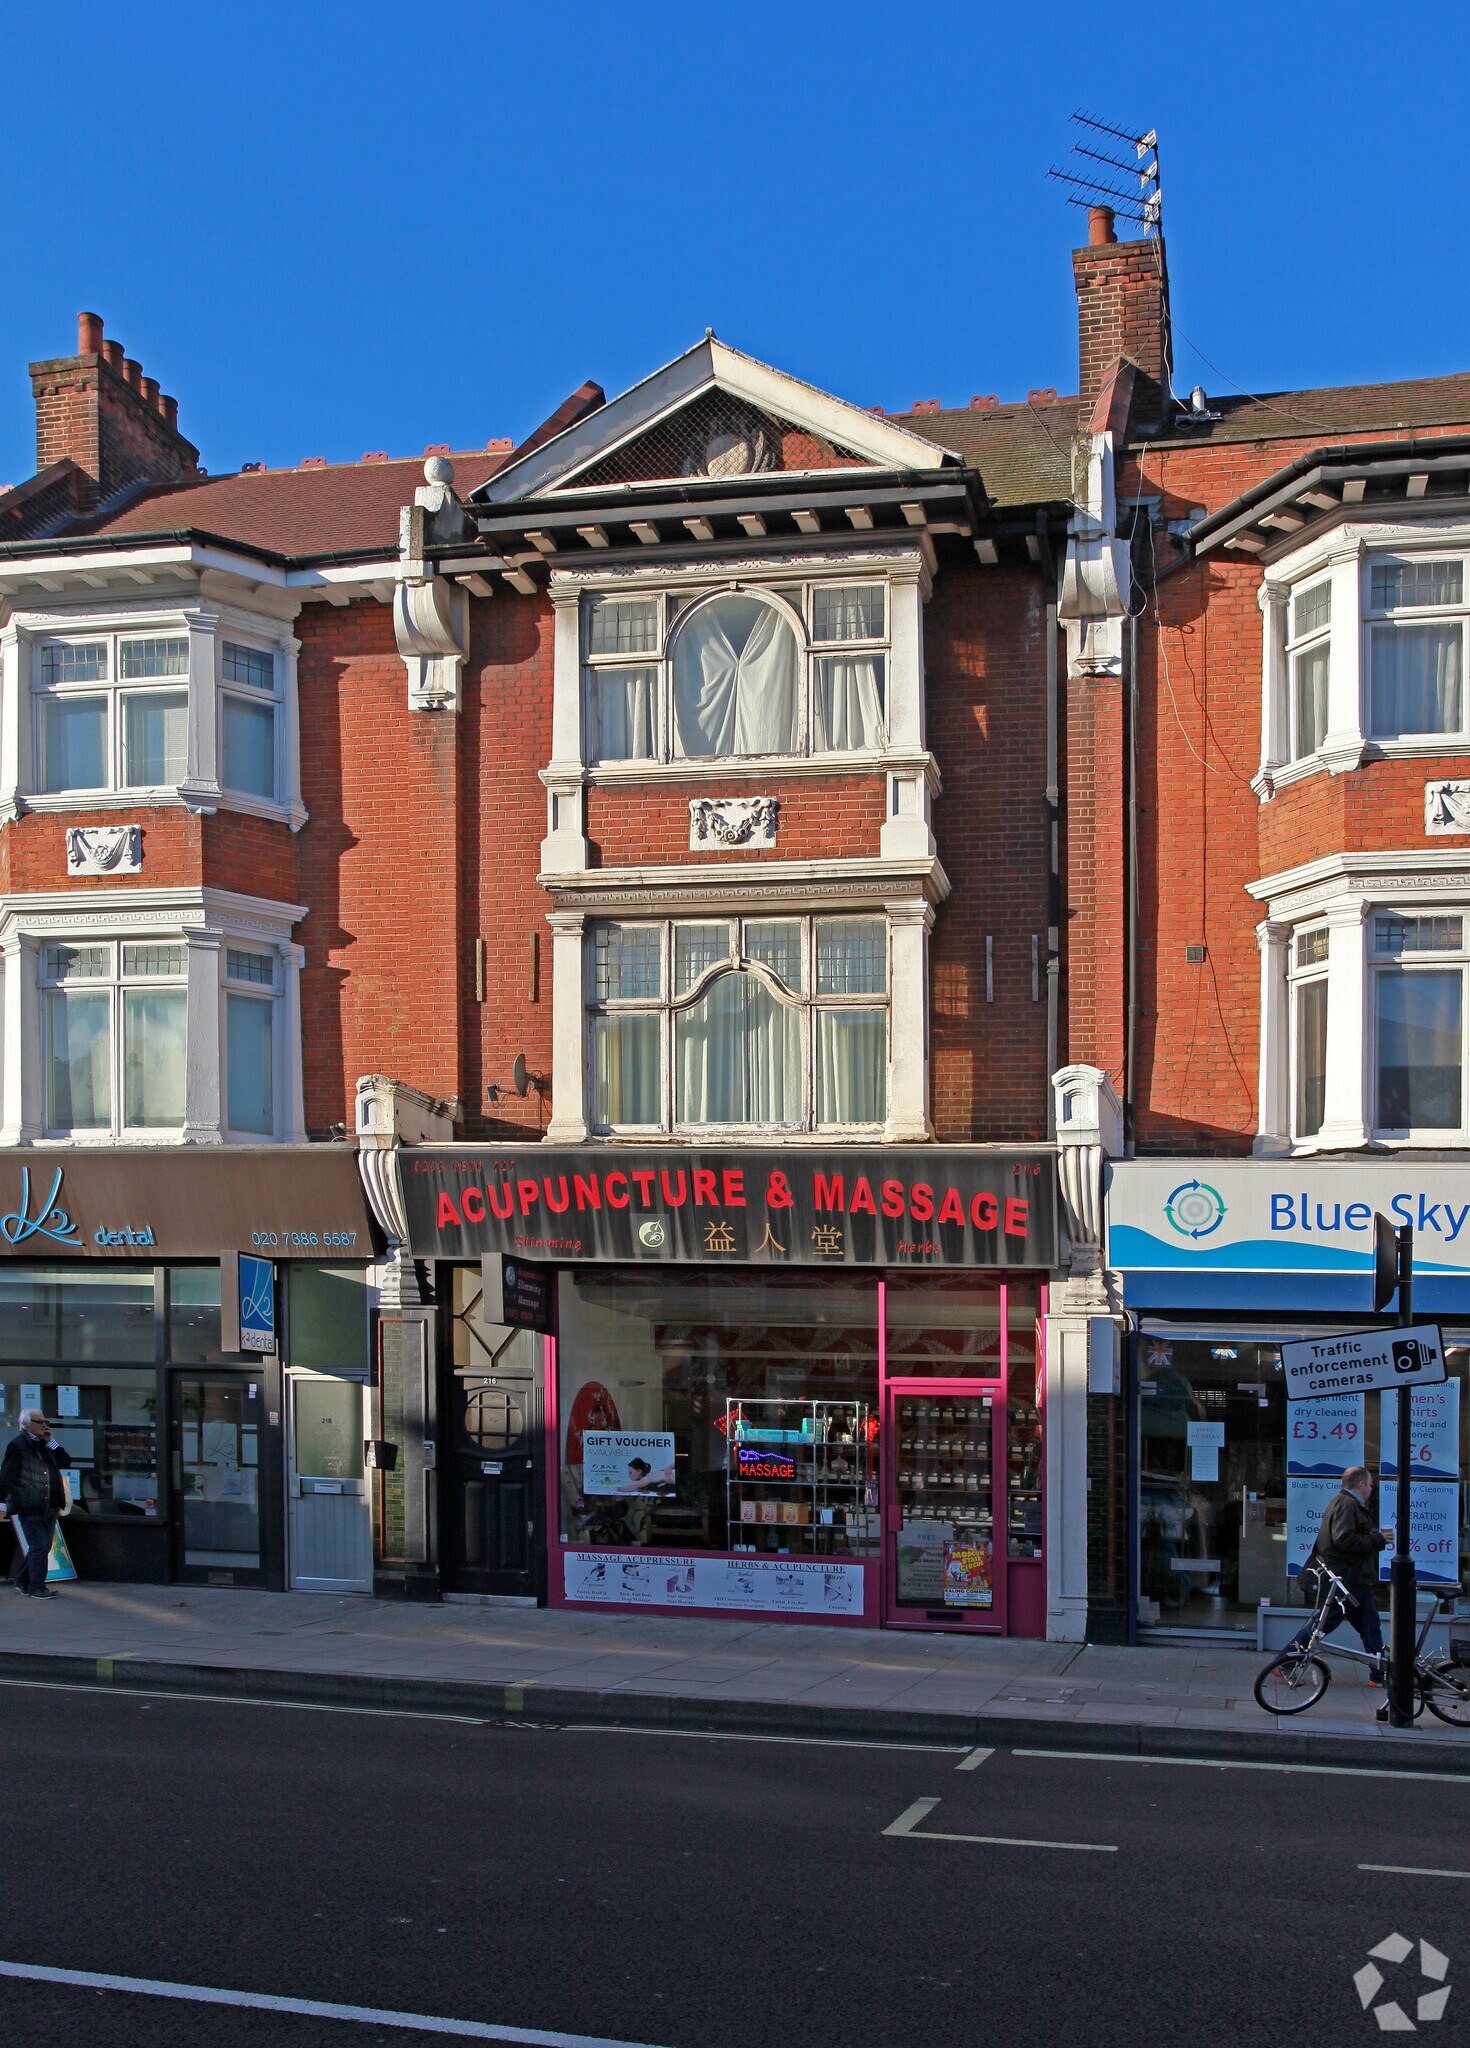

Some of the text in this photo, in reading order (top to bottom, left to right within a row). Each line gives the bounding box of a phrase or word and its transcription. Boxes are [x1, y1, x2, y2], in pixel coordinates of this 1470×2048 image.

[1014, 1162, 1042, 1176] 216
[436, 1169, 1029, 1238] ACUPUNCTURE & MASSAGE
[1270, 1192, 1470, 1242] Blue Sky
[94, 1225, 157, 1247] dental
[251, 1232, 358, 1246] 020 7386 5587
[703, 1220, 845, 1257] 益人堂
[514, 1235, 583, 1251] Slimming
[896, 1239, 941, 1254] Herbs
[1310, 1342, 1362, 1358] Traffic
[1290, 1352, 1388, 1377] enforcement
[483, 1377, 497, 1385] 216
[1309, 1373, 1374, 1391] cameras
[1294, 1407, 1357, 1418] dry cleaned
[1292, 1420, 1358, 1440] £3.49
[1429, 1420, 1447, 1429] and
[1411, 1431, 1435, 1439] oned
[586, 1436, 672, 1449] GIFT VOUCHER
[586, 1448, 632, 1457] AVAILABLE
[738, 1463, 795, 1478] MASSAGE
[1291, 1481, 1309, 1489] Blue
[1310, 1481, 1324, 1491] Sky
[1384, 1484, 1398, 1492] Blu
[1419, 1485, 1454, 1495] Cleaning
[1410, 1500, 1429, 1509] ANY
[1390, 1511, 1447, 1520] AERATION
[1411, 1523, 1443, 1532] REPAIR
[1427, 1539, 1453, 1553] off
[576, 1553, 697, 1566] MASSAGE ACUPRESSURE
[951, 1550, 985, 1560] MOSCOW
[961, 1556, 981, 1565] STATE
[727, 1560, 846, 1573] HERBS & ACUPUNCTURE
[960, 1560, 985, 1572] CIRCUS
